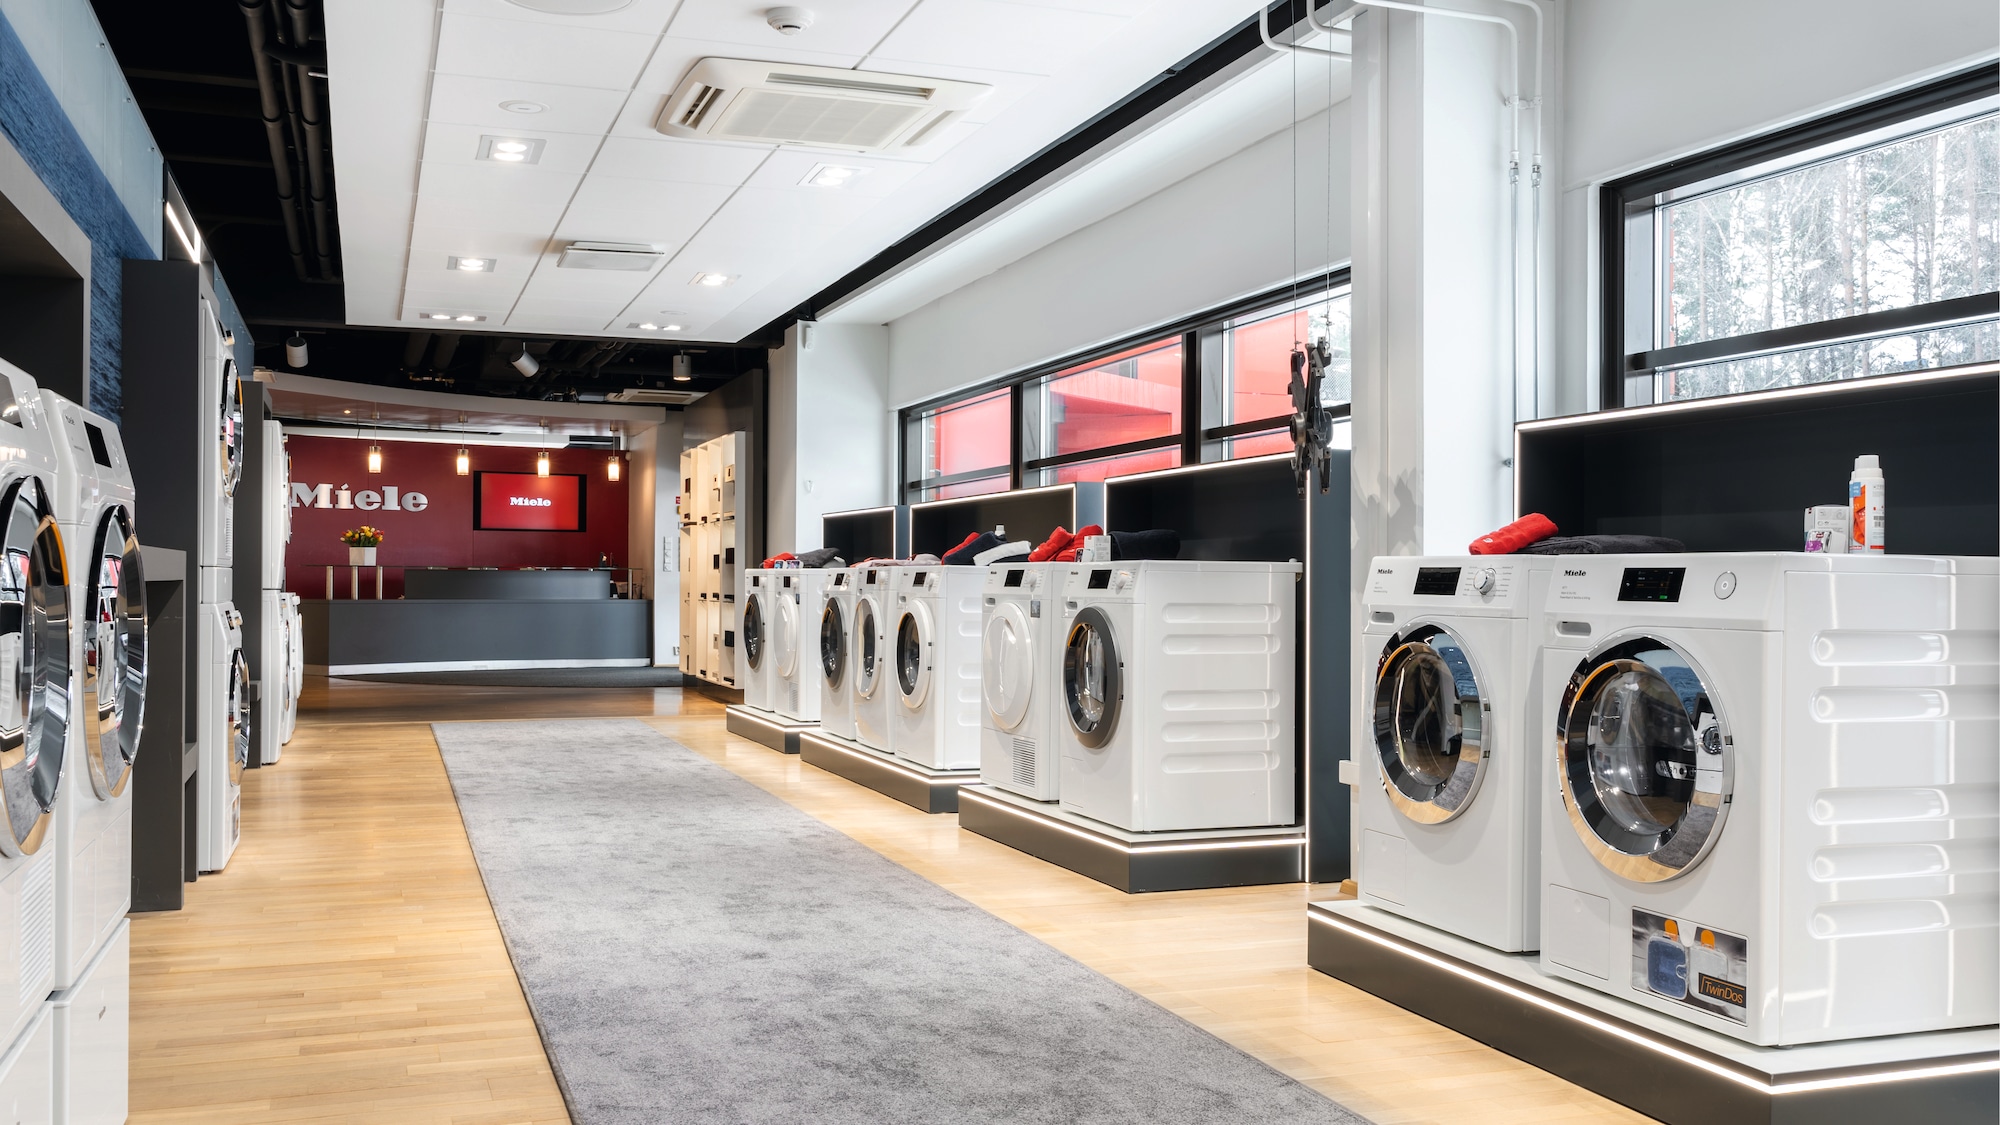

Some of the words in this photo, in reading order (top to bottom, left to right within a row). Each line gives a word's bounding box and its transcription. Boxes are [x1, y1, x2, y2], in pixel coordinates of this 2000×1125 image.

[292, 482, 428, 512] Miele
[509, 496, 551, 507] Miele
[1705, 981, 1743, 1004] TwinDos
